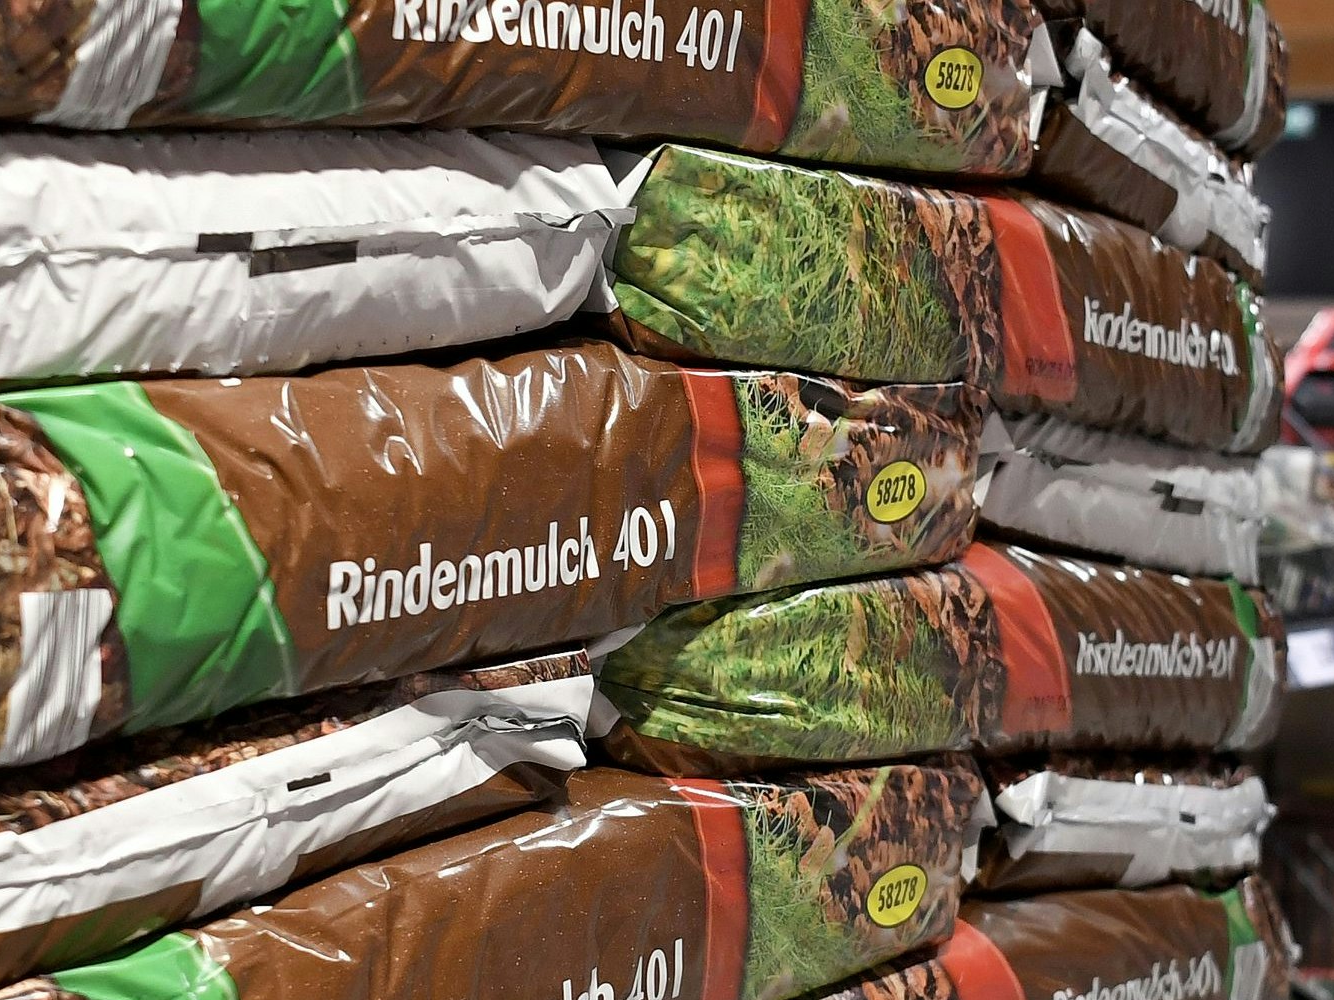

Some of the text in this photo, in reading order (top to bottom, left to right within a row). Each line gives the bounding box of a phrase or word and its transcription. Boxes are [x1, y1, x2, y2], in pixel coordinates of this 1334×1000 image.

[936, 61, 974, 92] 58278
[876, 473, 915, 507] 58278
[327, 516, 600, 631] Rindenmulch
[878, 876, 918, 912] 58278
